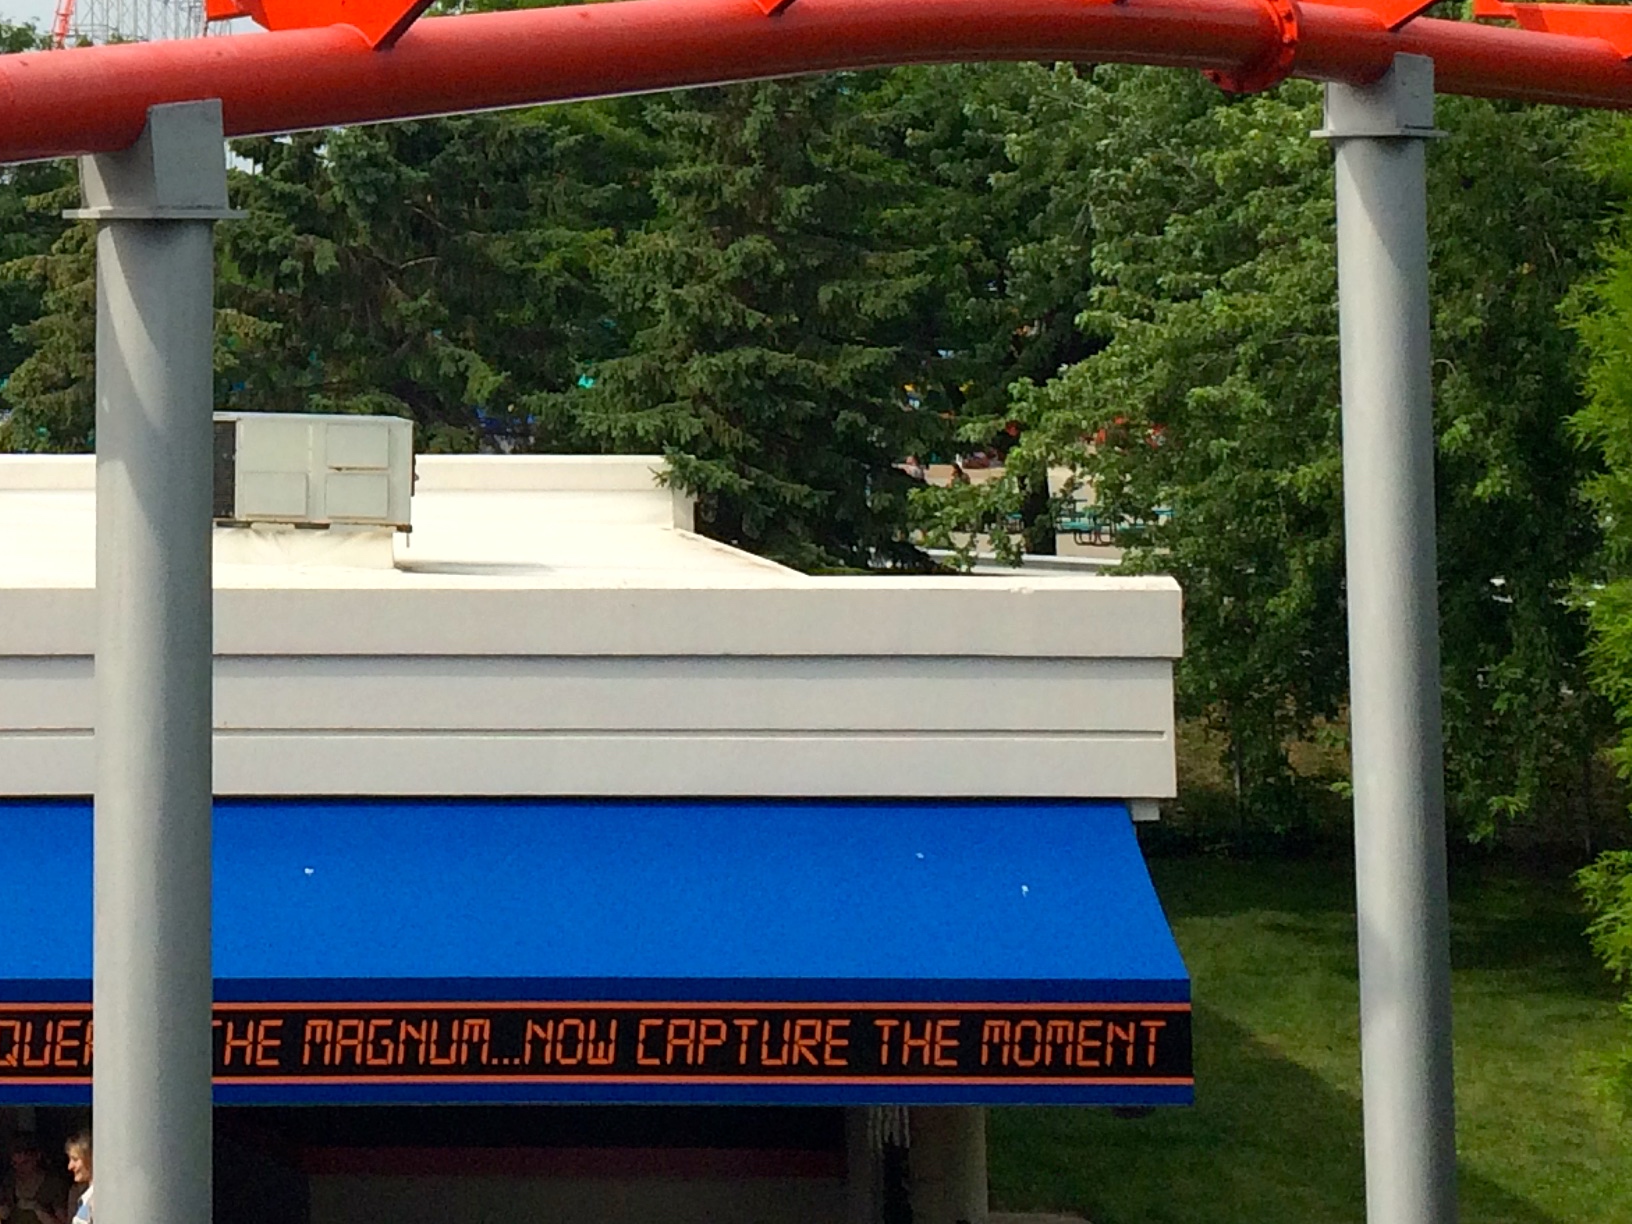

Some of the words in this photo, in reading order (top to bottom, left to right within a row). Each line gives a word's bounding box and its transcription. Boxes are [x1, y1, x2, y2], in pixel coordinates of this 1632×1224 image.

[636, 1018, 851, 1066] CAPTURE
[873, 1019, 961, 1066] THE
[980, 1019, 1167, 1067] MOMENT
